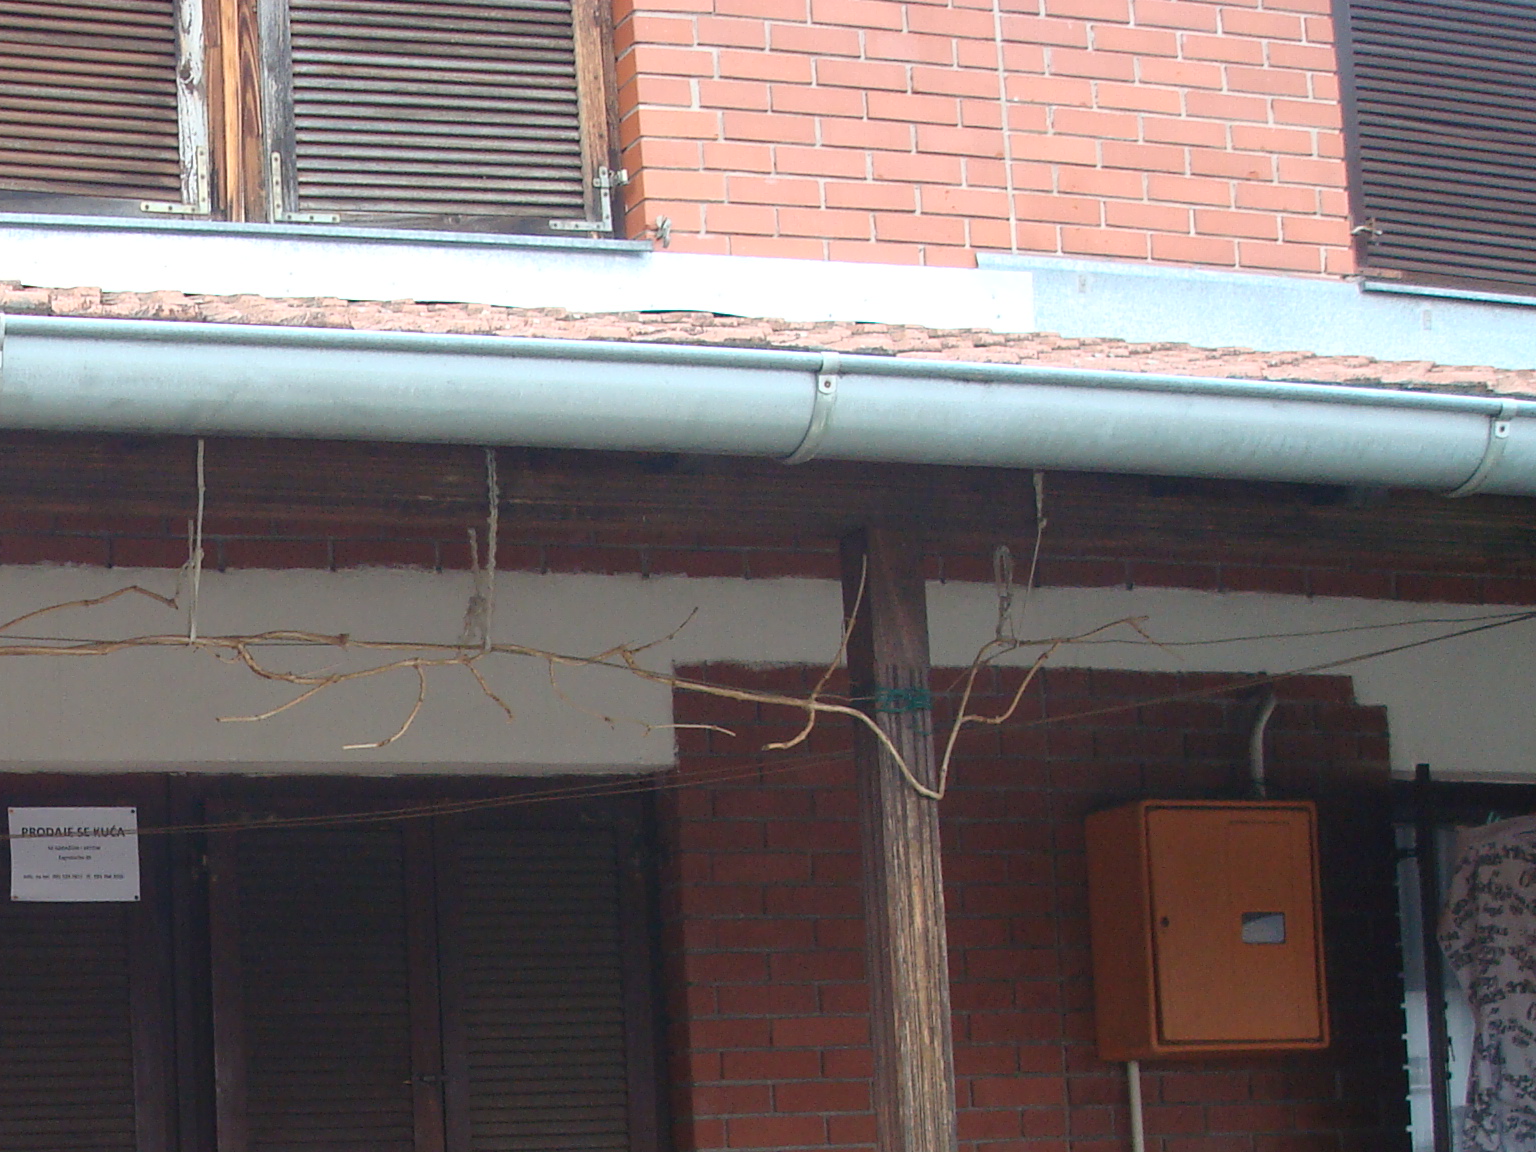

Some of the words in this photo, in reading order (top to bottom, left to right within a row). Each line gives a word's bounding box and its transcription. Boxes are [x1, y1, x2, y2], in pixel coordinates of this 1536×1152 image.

[21, 827, 73, 838] PRODAJE
[77, 827, 90, 837] SE
[93, 825, 126, 837] KUĆA
